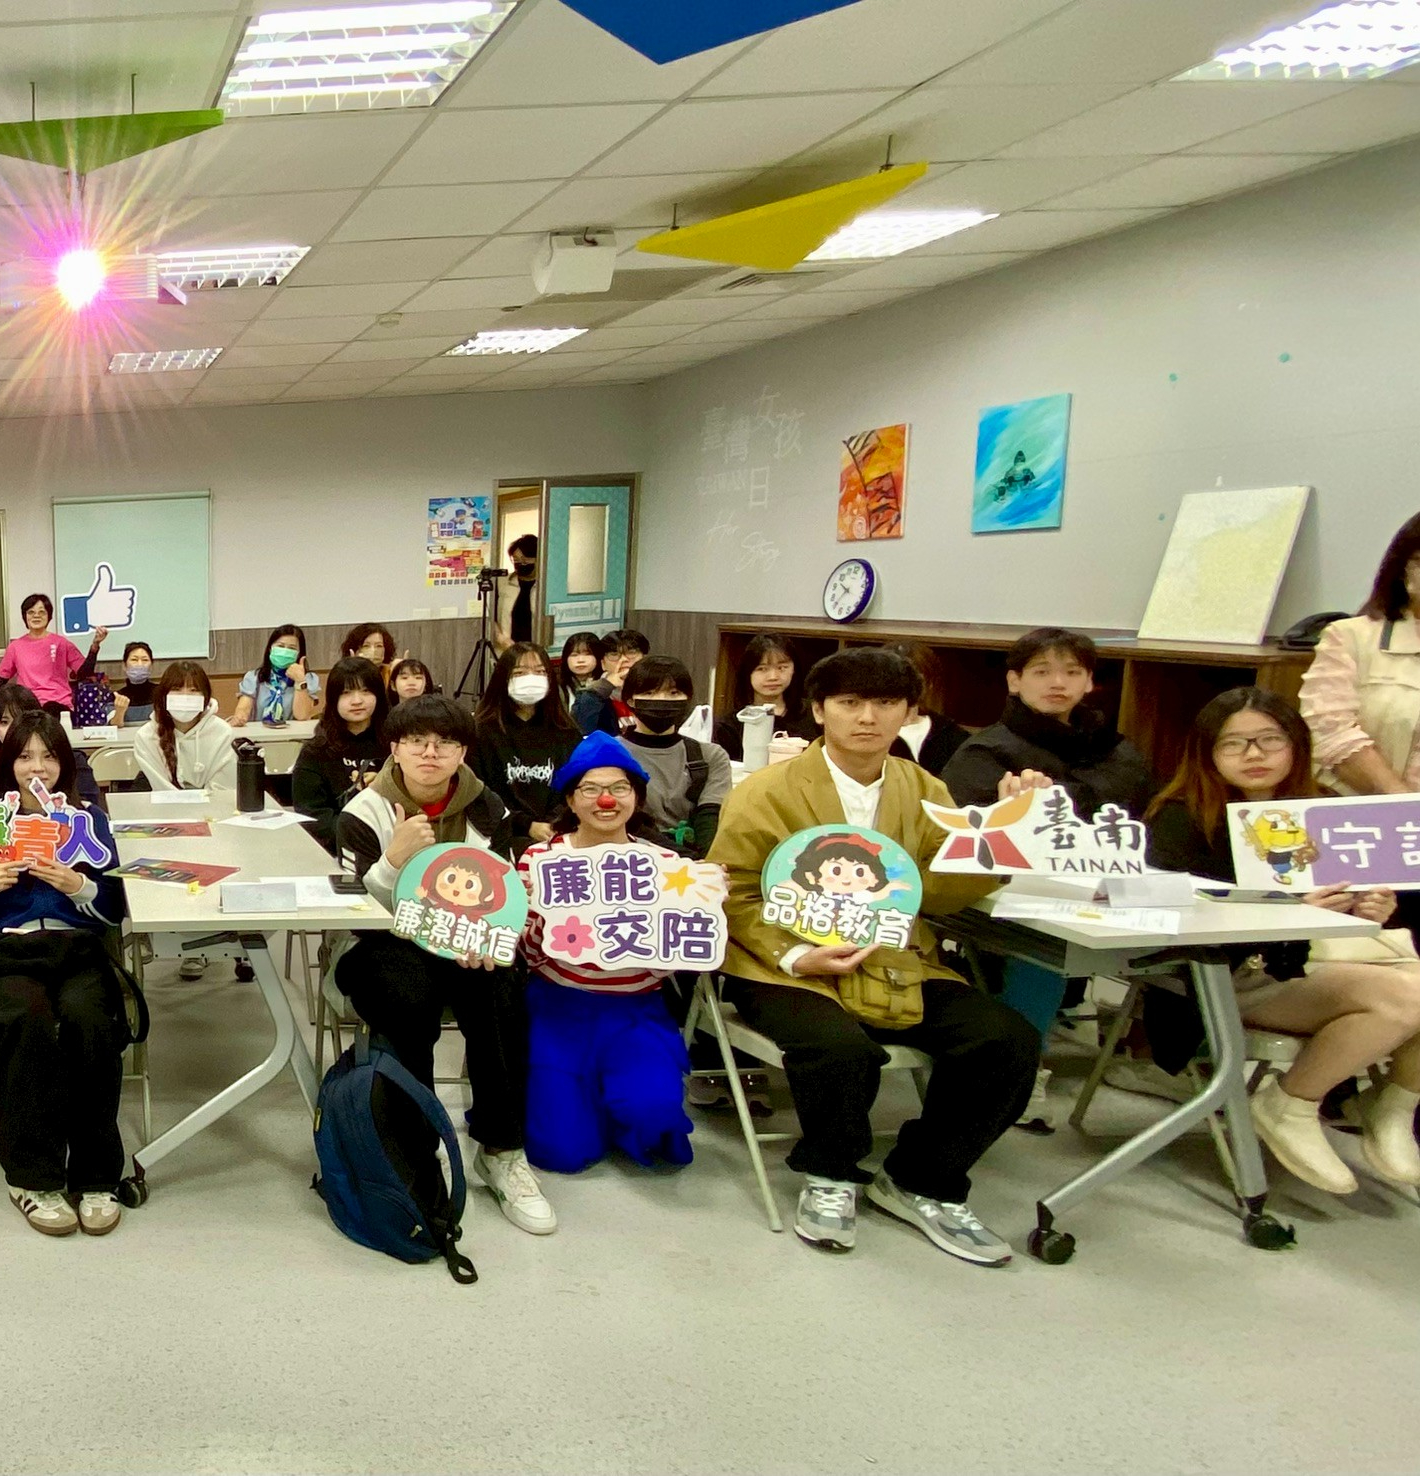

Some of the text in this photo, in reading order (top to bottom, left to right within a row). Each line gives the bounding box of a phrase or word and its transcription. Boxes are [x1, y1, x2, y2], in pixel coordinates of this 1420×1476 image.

[1033, 789, 1141, 851] 臺南
[541, 854, 656, 905] 廉能
[1045, 857, 1143, 874] TAINAN
[394, 899, 519, 964] 廉潔誠信
[598, 911, 715, 960] 交陪
[762, 885, 914, 949] 品格教育
